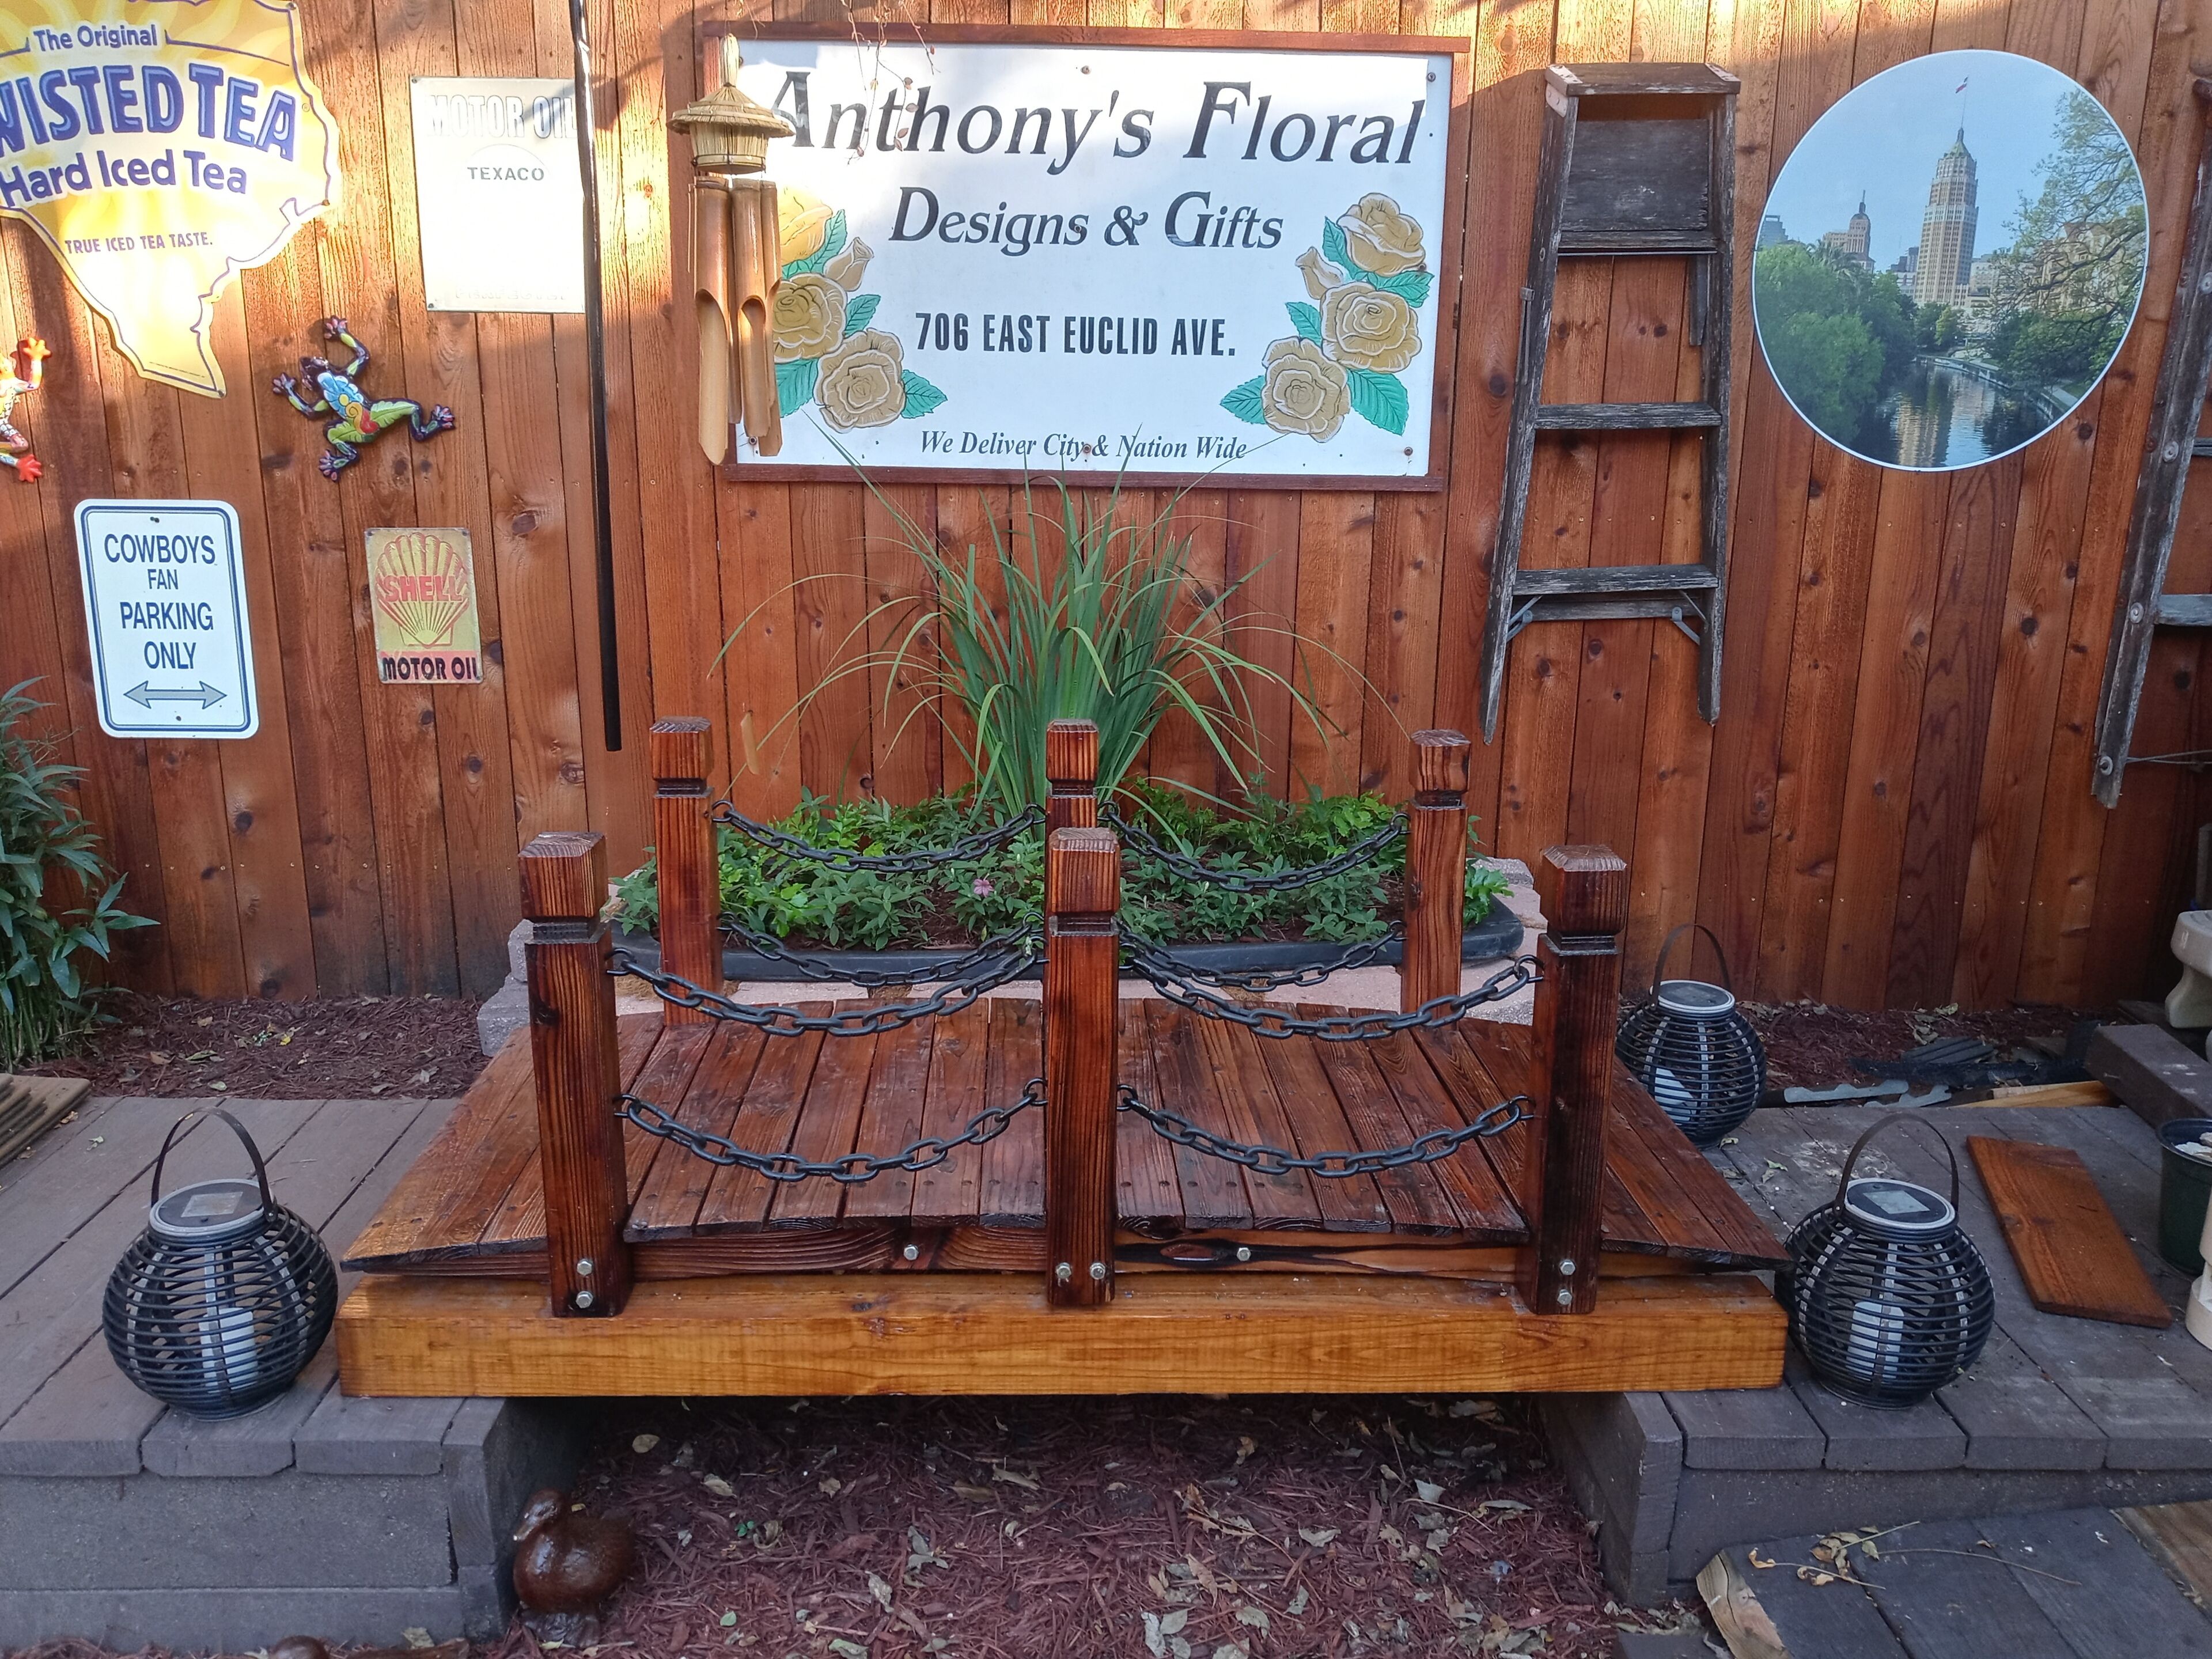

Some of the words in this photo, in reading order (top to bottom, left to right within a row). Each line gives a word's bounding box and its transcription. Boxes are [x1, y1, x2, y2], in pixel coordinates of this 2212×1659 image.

[33, 30, 73, 52] The
[77, 24, 158, 47] Original
[189, 63, 296, 161] TEA
[427, 94, 525, 138] MOTOR
[533, 96, 578, 138] OIL
[771, 71, 1154, 175] Anthony's
[1183, 81, 1425, 164] Floral
[0, 152, 92, 208] Hard
[99, 149, 176, 188] Iced
[183, 150, 247, 194] Tea
[467, 167, 545, 181] TEXACO
[888, 187, 1089, 257] Designs
[1104, 205, 1149, 246] &
[1165, 191, 1284, 249] Gifts
[65, 238, 101, 254] TRUE
[107, 237, 135, 252] ICED
[139, 234, 165, 250] TEA
[169, 232, 213, 248] TASTE.
[915, 312, 969, 352] 706
[983, 314, 1050, 353] EAST
[1064, 316, 1158, 355] EUCLID
[1171, 318, 1236, 357] AVE.
[921, 430, 953, 454] We
[959, 431, 1037, 456] Deliver
[1043, 433, 1085, 463] City
[1092, 435, 1109, 457] &
[1116, 435, 1187, 459] Nation
[1192, 436, 1247, 460] Wide
[104, 533, 215, 564] COWBOYS
[147, 569, 179, 590] FAN
[384, 575, 463, 602] SHELL
[120, 602, 214, 630] PARKING
[144, 641, 197, 669] ONLY
[381, 657, 447, 680] MOTOR
[452, 657, 481, 681] OIL
